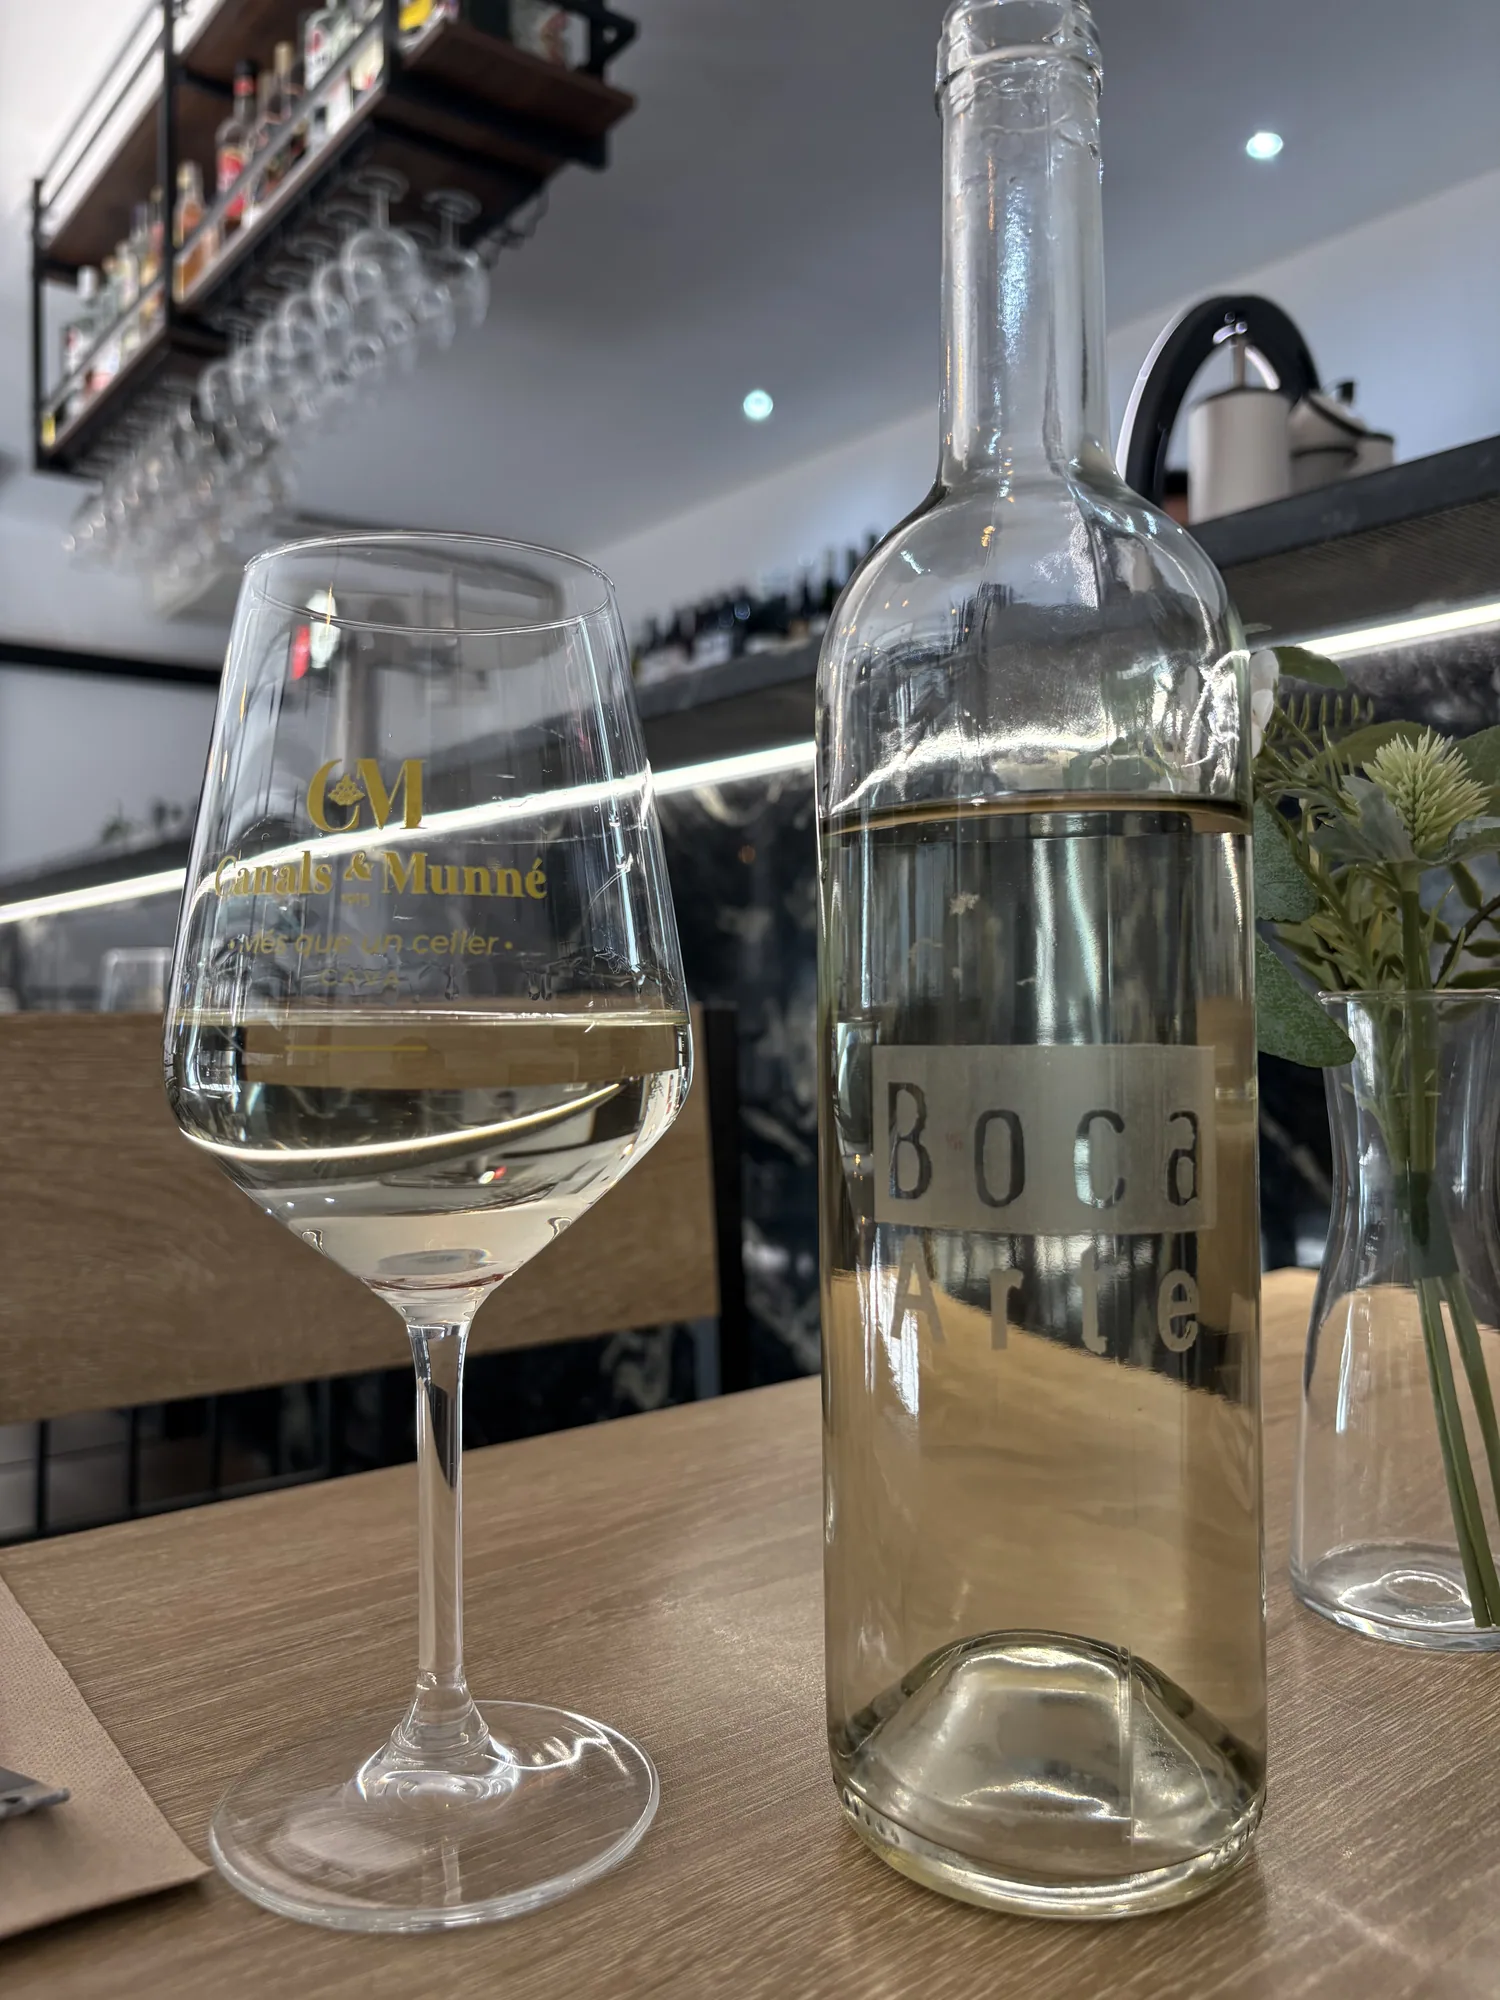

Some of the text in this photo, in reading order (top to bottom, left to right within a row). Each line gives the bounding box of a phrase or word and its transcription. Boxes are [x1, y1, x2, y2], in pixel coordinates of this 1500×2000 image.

[307, 758, 428, 833] CM
[215, 850, 548, 900] Canals & Munné
[295, 933, 353, 959] que
[361, 933, 404, 955] un
[411, 929, 499, 955] celler
[889, 1234, 1200, 1356] Arte
